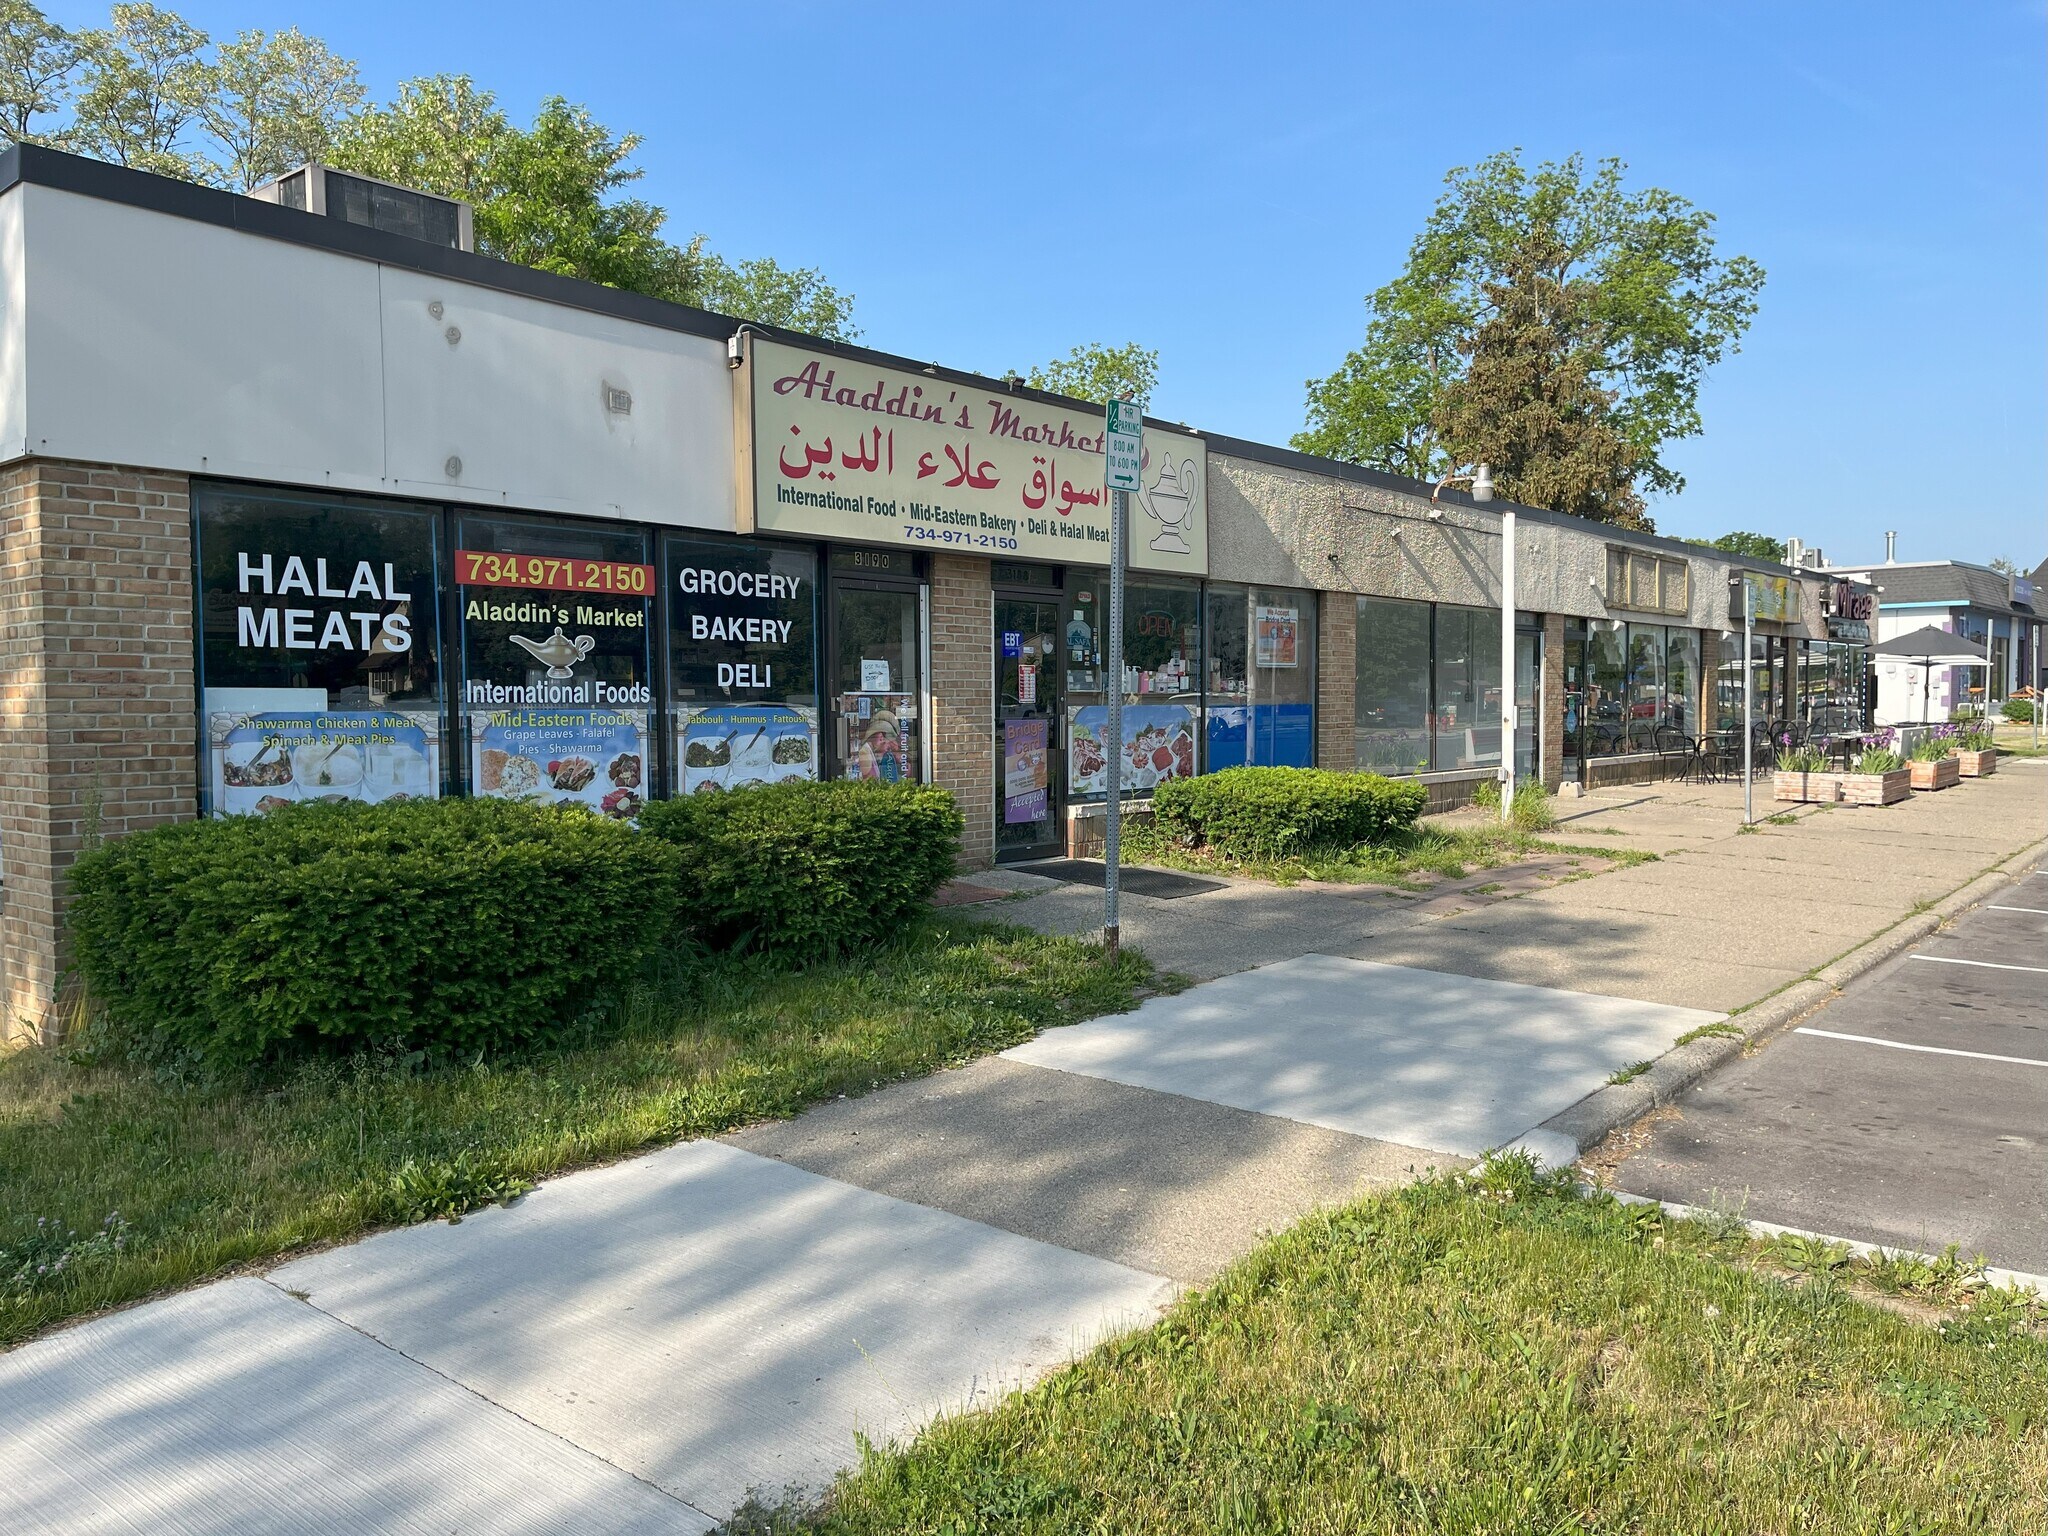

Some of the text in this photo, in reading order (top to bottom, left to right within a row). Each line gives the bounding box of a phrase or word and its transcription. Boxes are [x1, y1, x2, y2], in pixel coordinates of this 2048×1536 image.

[773, 361, 1106, 455] Aladdin's Market
[1118, 420, 1140, 434] PARKING
[1127, 443, 1135, 454] AM
[1109, 455, 1116, 467] TO
[1131, 460, 1138, 470] PM
[777, 484, 1110, 543] International Food Mid-Eastern Bakery Deli & Halal Meat
[903, 526, 1017, 550] 734-971-2150
[855, 552, 889, 568] 3190
[238, 552, 411, 601] HALAL
[466, 554, 645, 592] 734.971.2150
[679, 567, 800, 599] GROCERY
[466, 601, 644, 627] Aladdin's Market
[238, 606, 412, 652] MEATS
[692, 615, 792, 643] BAKERY
[1138, 614, 1174, 637] OPEN
[1004, 632, 1020, 647] EBT
[717, 663, 771, 688] DELI
[466, 680, 650, 704] International Foods
[900, 698, 908, 713] We
[238, 717, 415, 731] Shawarma Chicken & Meat
[491, 712, 632, 728] Mid-Eastern Foods
[687, 714, 723, 724] Tabbouli
[730, 714, 767, 724] Hummus
[773, 714, 808, 724] Fattoush
[901, 716, 909, 731] sell
[503, 729, 536, 743] Grape
[539, 729, 573, 740] Leaves
[583, 728, 615, 739] Falafel
[1007, 721, 1044, 739] Bridge
[263, 733, 396, 748] Spinach & Meat Pies
[518, 744, 539, 755] Pies
[549, 743, 602, 755] Shawarma
[901, 733, 909, 751] fruit
[1013, 738, 1041, 755] Card
[900, 754, 908, 771] and
[1010, 789, 1044, 813] Accepted
[1031, 808, 1046, 820] here
